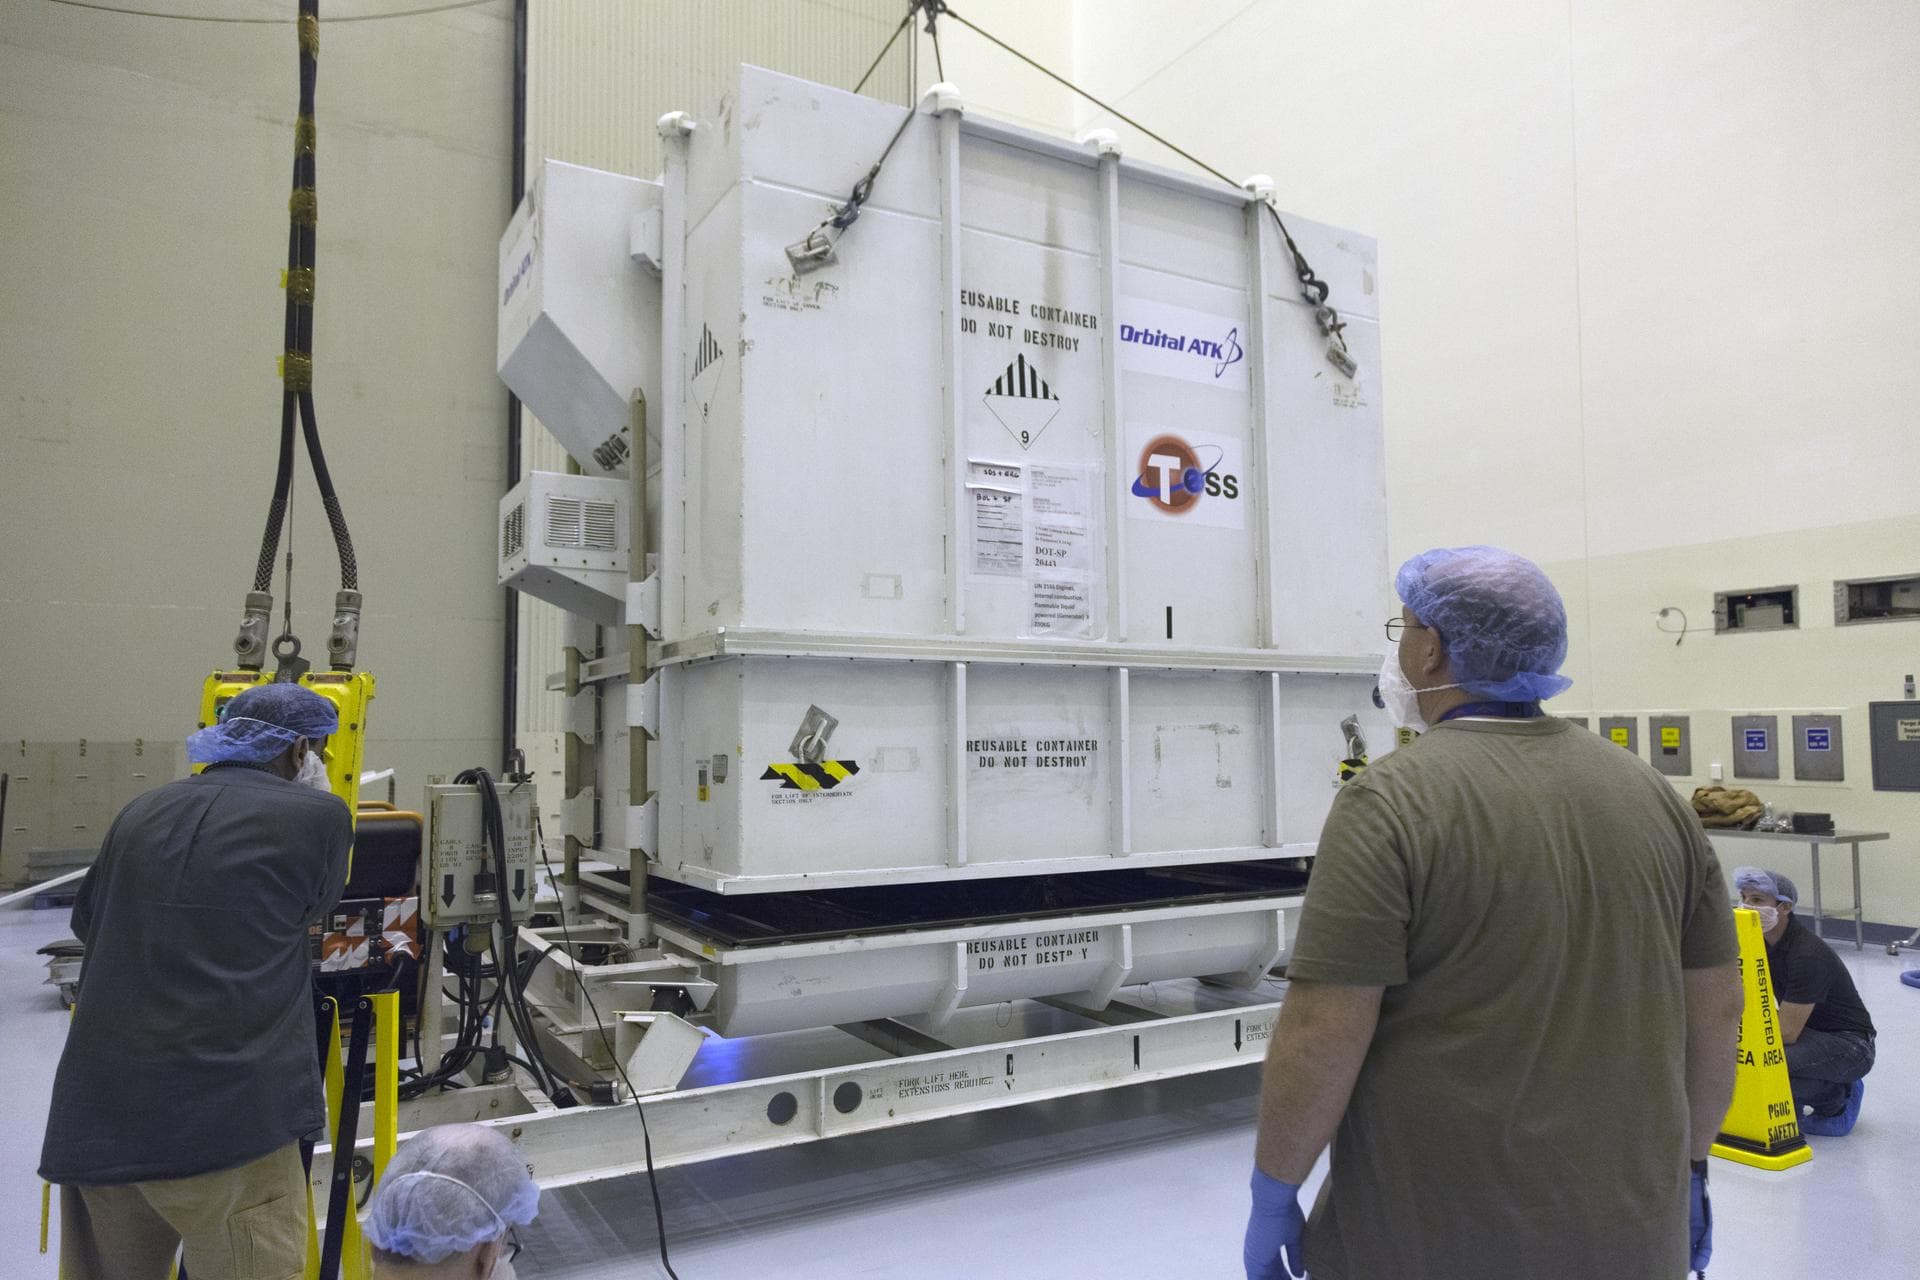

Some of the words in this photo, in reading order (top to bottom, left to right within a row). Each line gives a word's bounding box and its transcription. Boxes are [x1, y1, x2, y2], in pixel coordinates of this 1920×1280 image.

[961, 289, 1020, 315] EUSABLE
[1031, 303, 1097, 330] CONTAINER
[961, 318, 977, 334] DO
[989, 322, 1013, 340] NOT
[1024, 328, 1079, 352] DESTROY
[1120, 324, 1186, 352] Orbital
[1187, 338, 1223, 360] ATK
[1021, 430, 1029, 444] 9
[1035, 546, 1067, 558] DOT-SP
[966, 740, 1027, 752] REUSABLE
[1036, 740, 1098, 752] CONTAINER
[979, 756, 995, 768] DO
[1004, 756, 1028, 768] NOT
[1036, 756, 1087, 768] DESTROY
[967, 937, 1027, 954] REUSABLE
[1036, 930, 1099, 948] CONTAINER
[979, 957, 995, 970] DO
[1004, 953, 1028, 968] NOT
[1036, 948, 1088, 965] DESTY
[1756, 958, 1775, 1046] RESTRICTED
[1737, 1048, 1755, 1067] EA
[1763, 1048, 1784, 1067] AREA
[898, 1077, 920, 1088] FORK
[925, 1073, 945, 1085] LIFT
[898, 1082, 950, 1099] EXTENSIONS
[1768, 1121, 1797, 1143] SAFETY
